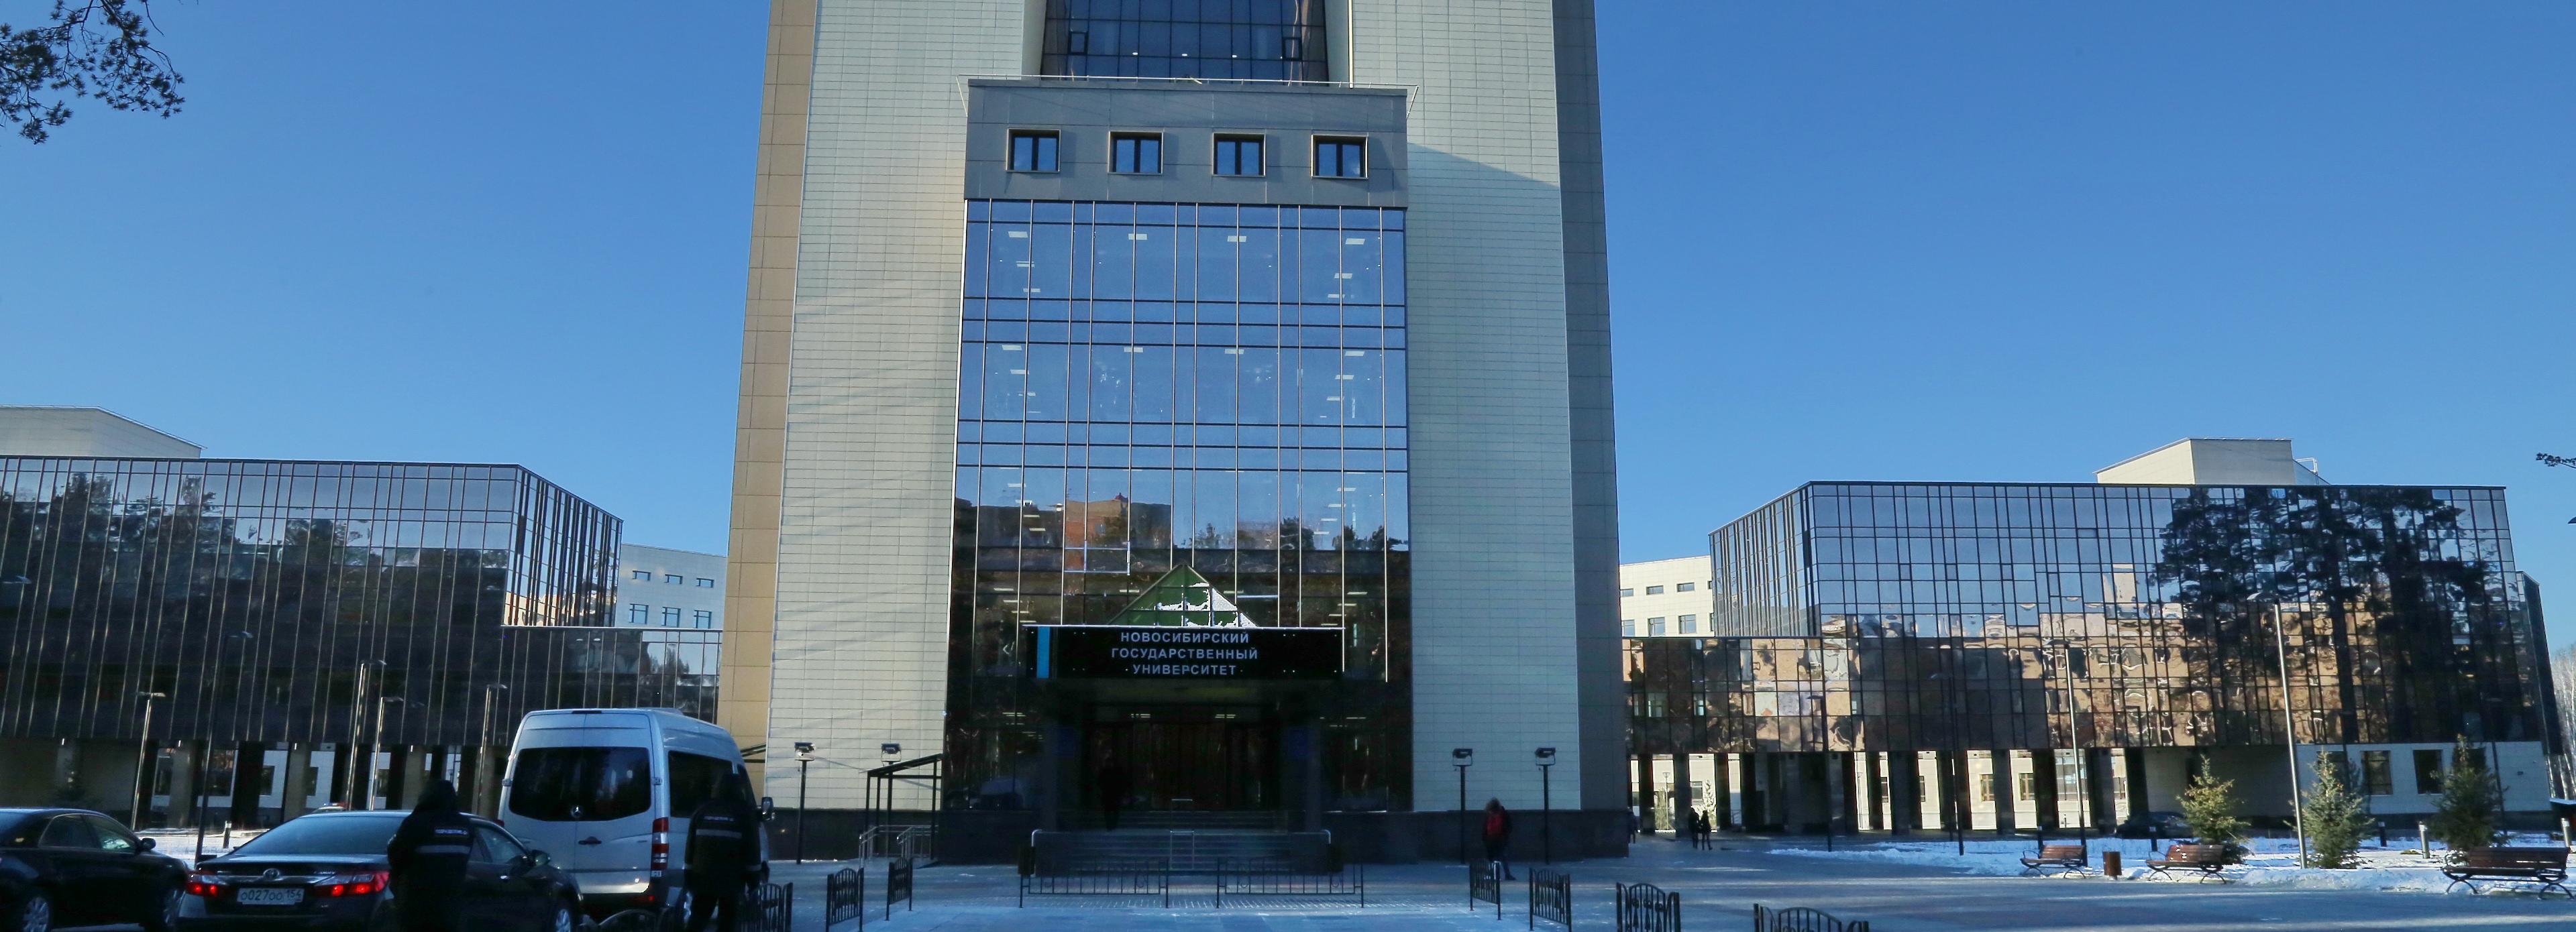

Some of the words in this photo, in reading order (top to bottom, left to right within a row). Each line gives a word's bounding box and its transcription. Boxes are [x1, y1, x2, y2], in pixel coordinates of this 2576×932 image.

[1121, 632, 1249, 644] НОВОСИБИРСКИЙ
[1112, 647, 1257, 660] ГОСУДАРСТВЕННЫЙ
[1133, 664, 1236, 675] УНИВЕРСИТЕТ
